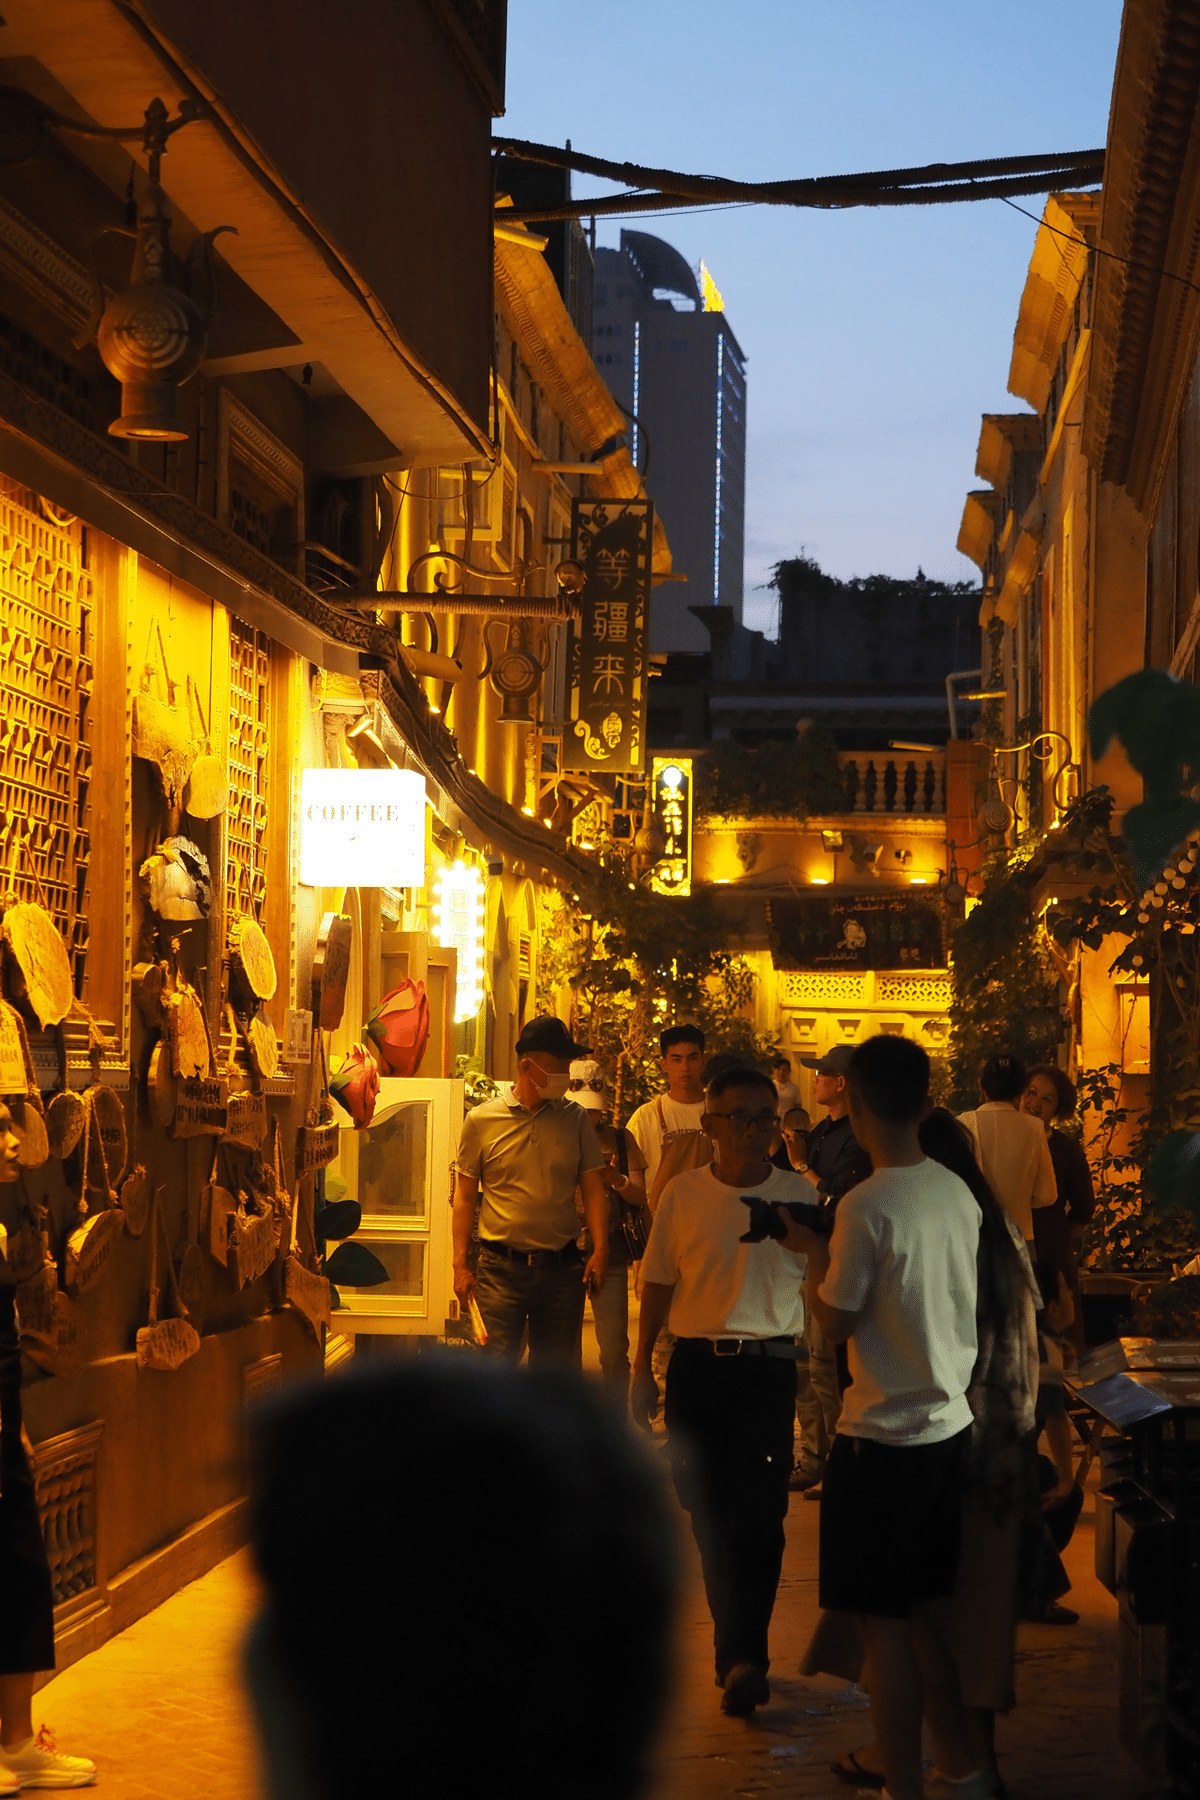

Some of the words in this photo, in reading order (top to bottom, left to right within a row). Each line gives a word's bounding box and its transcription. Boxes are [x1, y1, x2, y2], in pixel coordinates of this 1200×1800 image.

[591, 547, 632, 696] 等疆来
[306, 803, 399, 822] COFFEE
